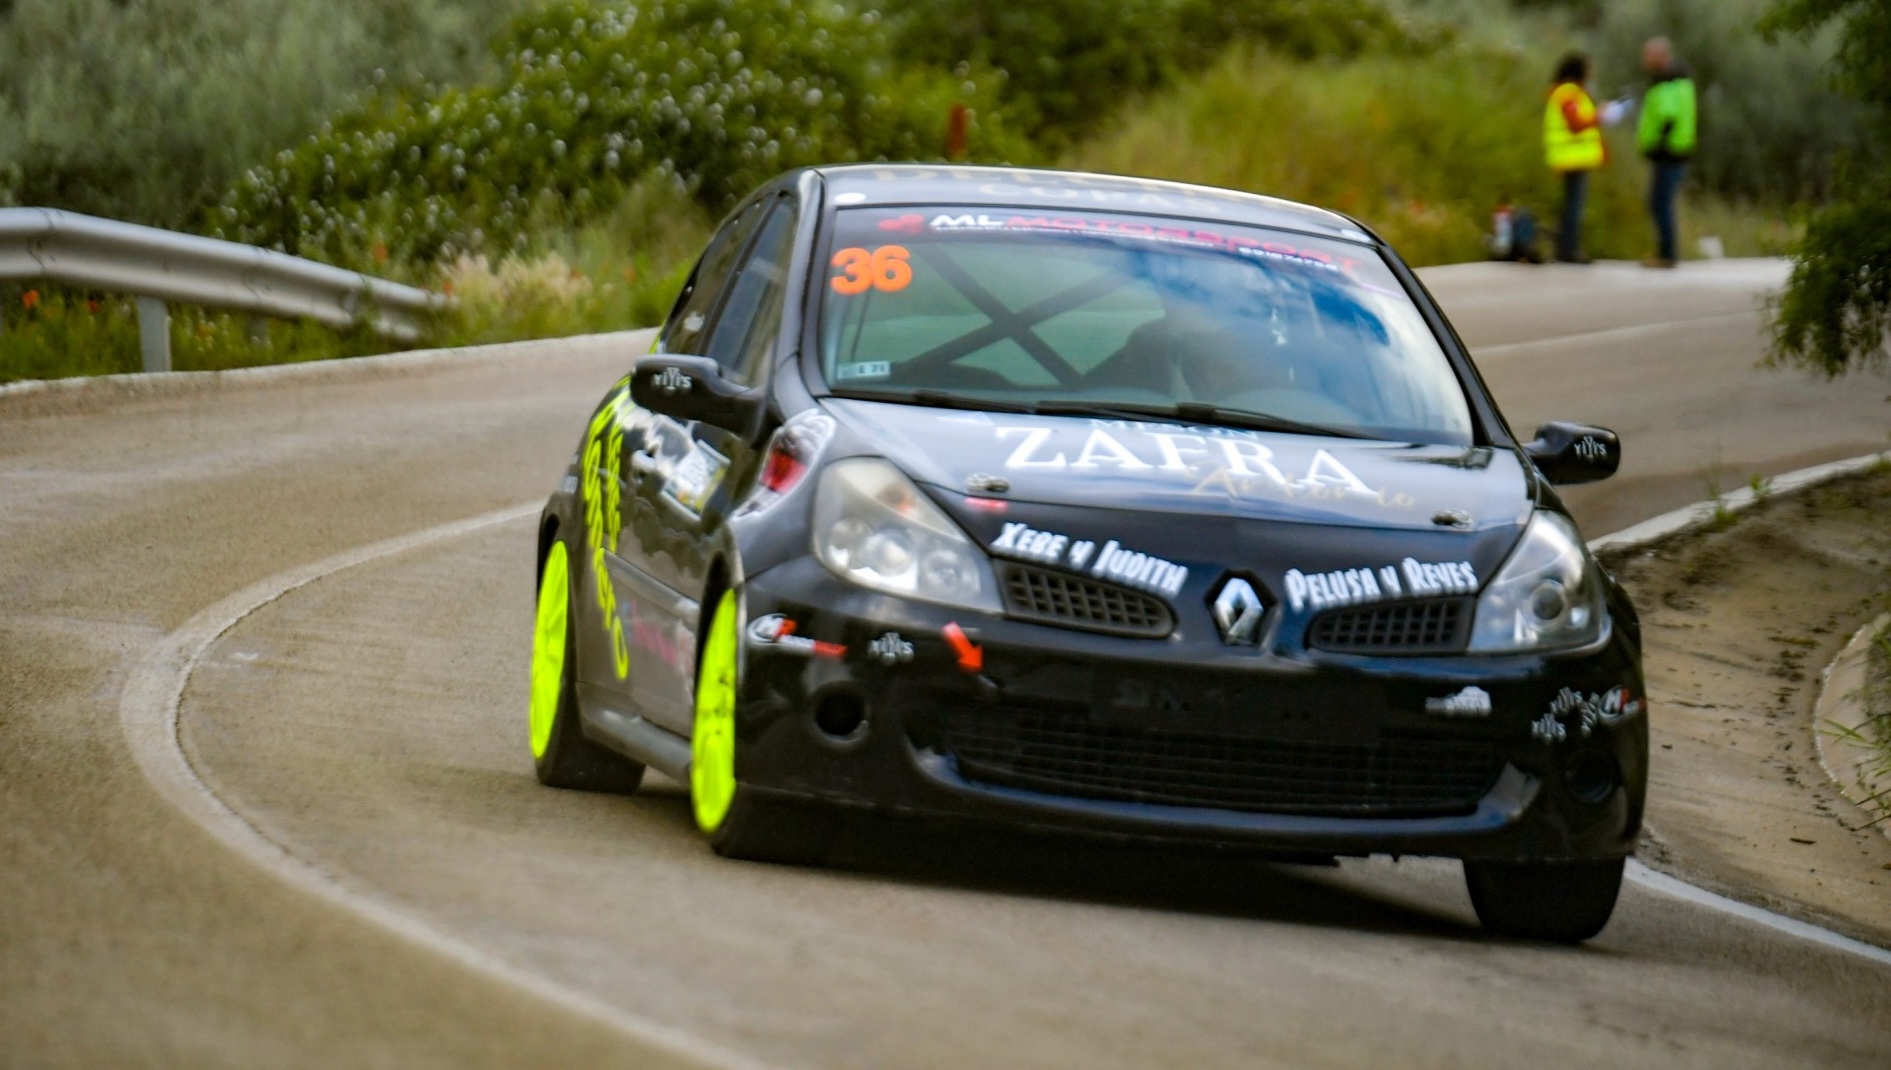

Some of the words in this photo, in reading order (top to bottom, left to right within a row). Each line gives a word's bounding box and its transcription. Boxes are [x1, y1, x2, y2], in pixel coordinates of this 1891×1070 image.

[830, 245, 912, 295] 36
[996, 427, 1380, 495] ZAFRA
[1284, 567, 1381, 612] PELUSA
[1402, 556, 1478, 597] REYES
